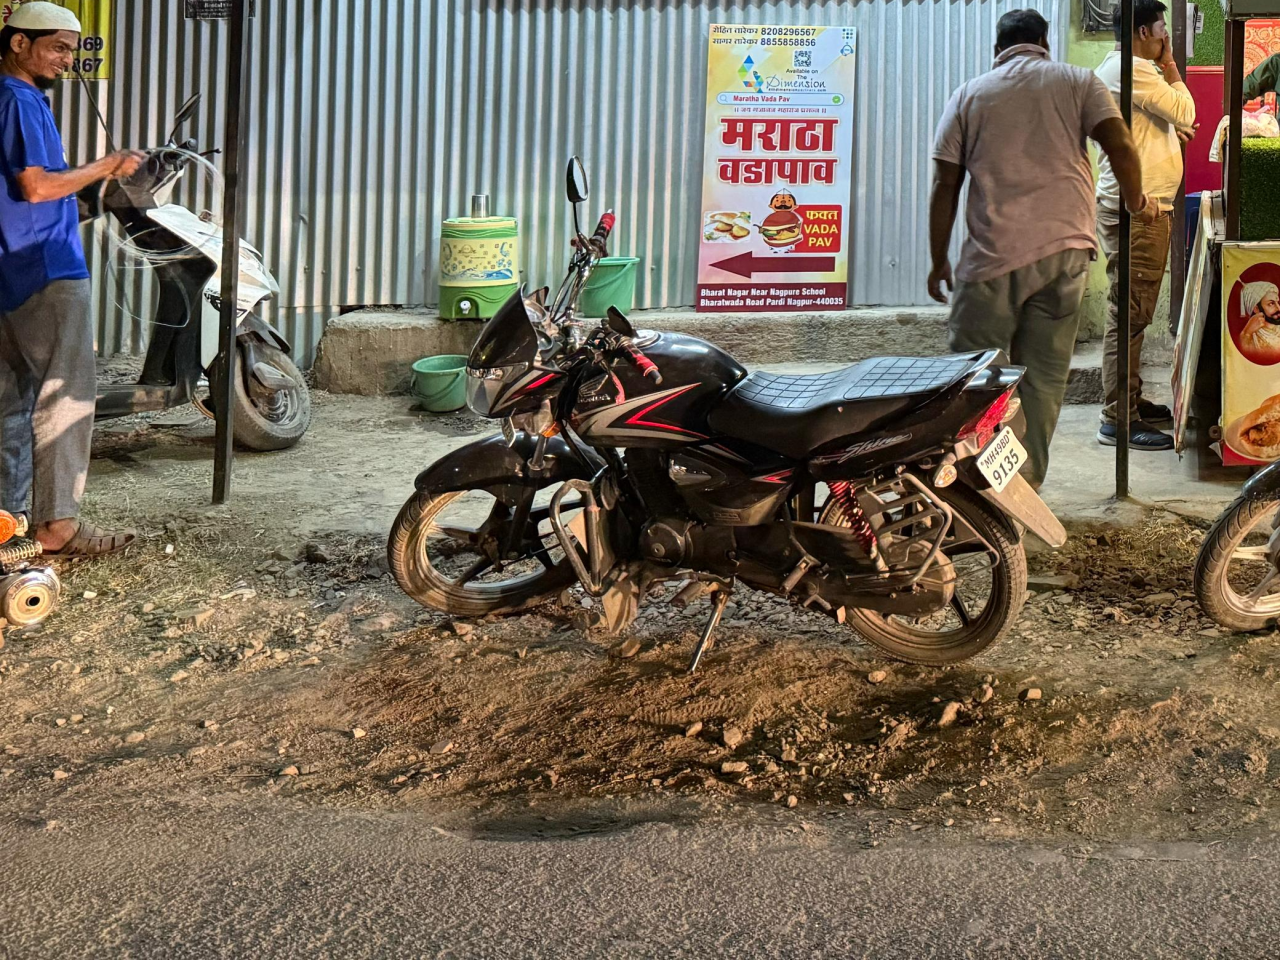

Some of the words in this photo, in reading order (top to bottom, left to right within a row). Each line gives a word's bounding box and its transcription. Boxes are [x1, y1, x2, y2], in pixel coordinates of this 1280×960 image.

[760, 27, 817, 36] 8208296567
[760, 38, 816, 47] 8855858856
[720, 117, 839, 152] मराठा
[718, 158, 838, 185] वडापाव
[805, 209, 838, 221] फक्त
[804, 223, 839, 235] VADA
[808, 236, 833, 248] PAV
[701, 288, 725, 296] Bharat
[727, 288, 749, 298] Nagar
[751, 288, 768, 296] Near
[770, 288, 800, 297] Nagpure
[802, 287, 826, 295] School
[700, 298, 744, 306] Bharatwada
[746, 298, 764, 306] Road
[766, 298, 785, 306] Pardi
[787, 297, 844, 307] Nagpur-440035
[983, 431, 1011, 469] MH49BD
[992, 448, 1020, 486] 9135
